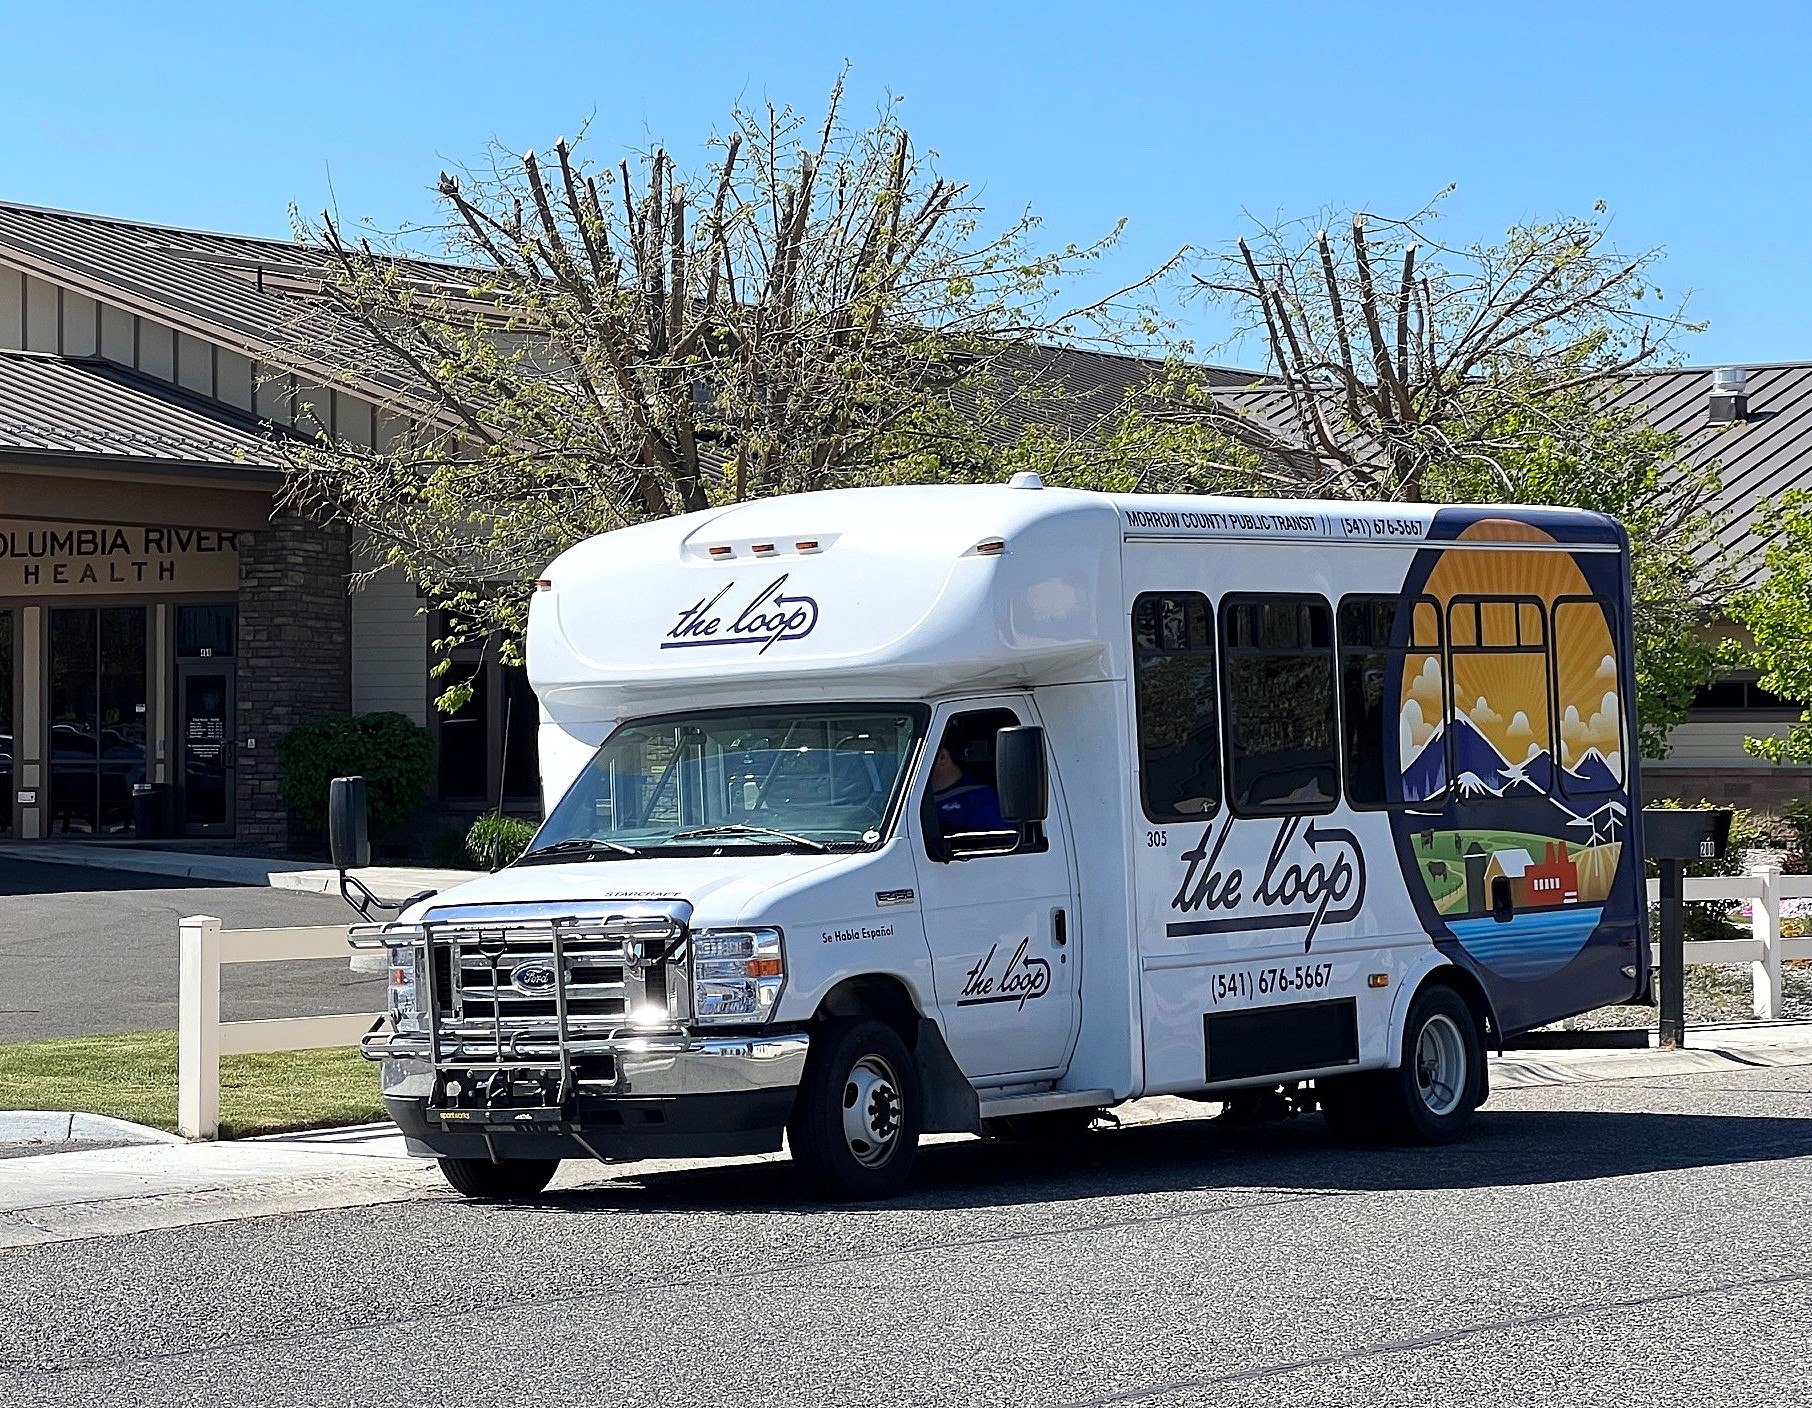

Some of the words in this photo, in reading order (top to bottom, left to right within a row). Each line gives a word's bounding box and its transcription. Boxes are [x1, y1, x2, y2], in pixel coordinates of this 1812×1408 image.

[1125, 510, 1180, 528] MORROW
[1181, 512, 1228, 529] COUNTY
[1228, 514, 1271, 530] PUBLIC
[1268, 515, 1317, 531] TRANSIT
[1340, 517, 1371, 538] (541)
[1373, 519, 1422, 536] 676-5667
[144, 528, 238, 554] RIVER
[24, 560, 175, 585] HEALTH
[667, 581, 735, 638] the
[726, 573, 807, 655] loop
[1146, 830, 1167, 848] 305
[1171, 813, 1242, 913] the
[1252, 815, 1352, 954] loop
[822, 932, 833, 943] Se
[834, 929, 860, 942] Habla
[861, 924, 894, 940] Español
[523, 969, 550, 983] Ford
[961, 942, 998, 996] the
[997, 936, 1045, 1012] loop
[1211, 970, 1253, 1004] (541)
[1258, 963, 1332, 994] 676-5667
